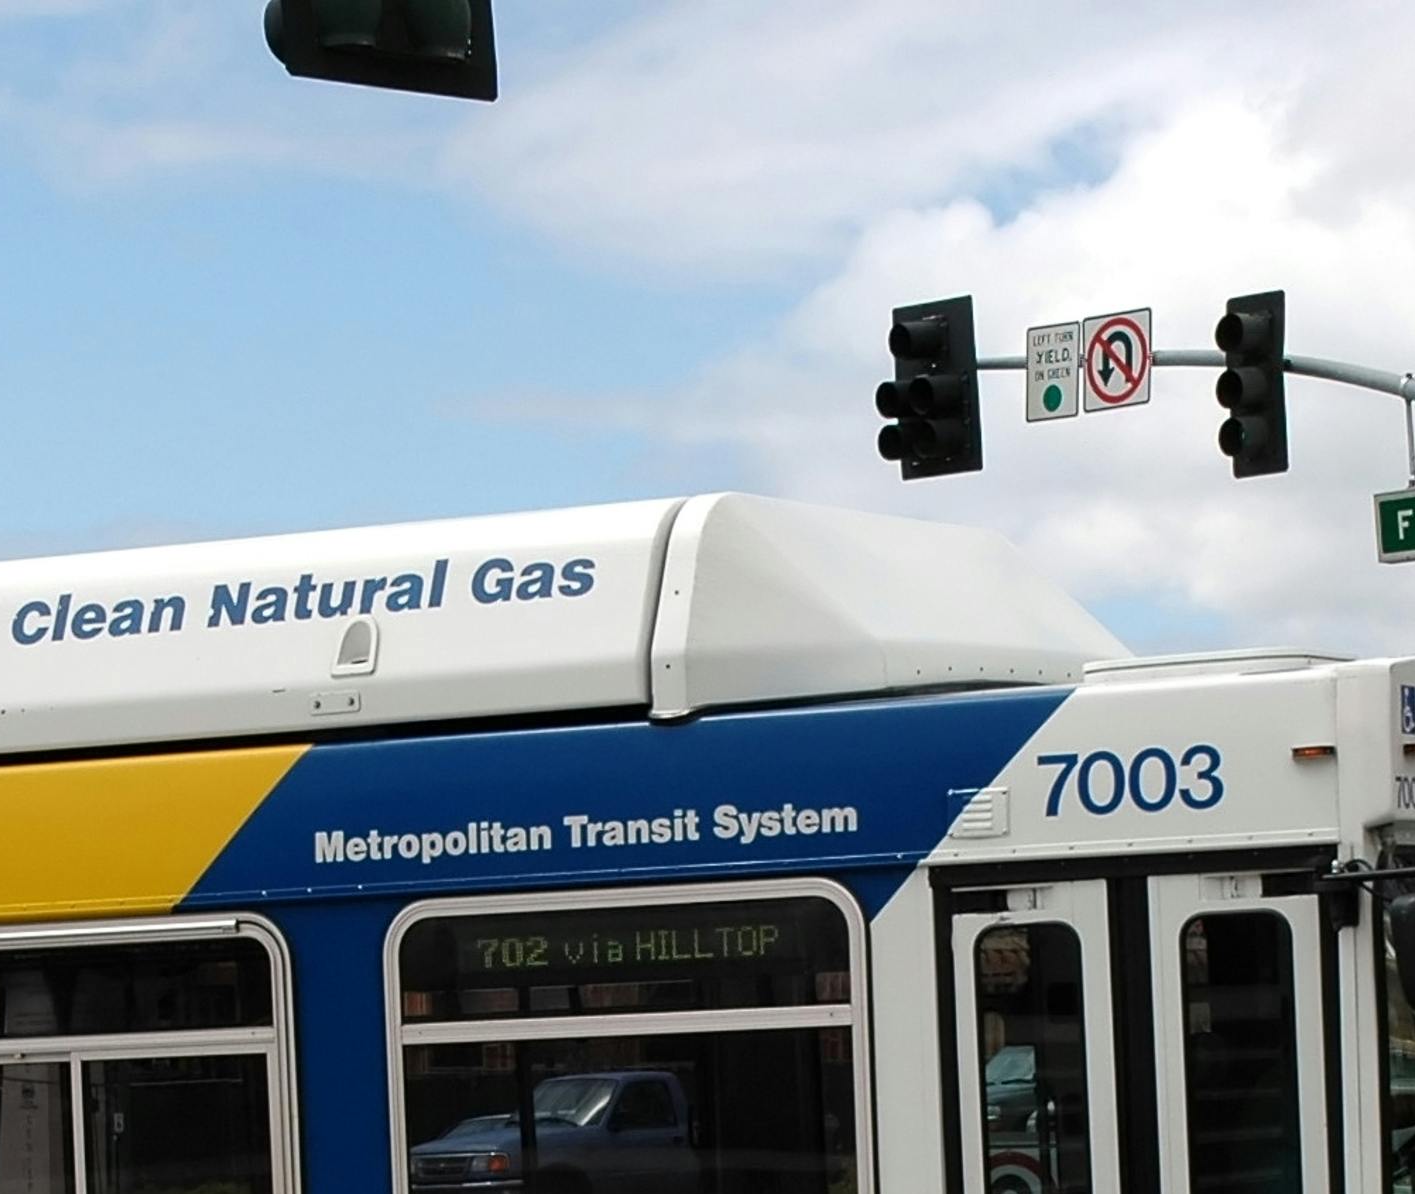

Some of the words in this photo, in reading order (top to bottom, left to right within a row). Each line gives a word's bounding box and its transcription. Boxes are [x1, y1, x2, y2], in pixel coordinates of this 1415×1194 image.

[1036, 347, 1070, 364] YIELD
[1397, 509, 1414, 541] F
[10, 593, 187, 646] Clean
[207, 558, 450, 628] Natural
[470, 556, 596, 603] Gas
[1037, 743, 1225, 818] 7003
[314, 821, 552, 865] Metropolitan
[563, 808, 701, 849] Transit
[712, 803, 859, 844] System
[477, 938, 550, 970] 702
[563, 932, 624, 964] via
[635, 925, 780, 962] HILLTOP
